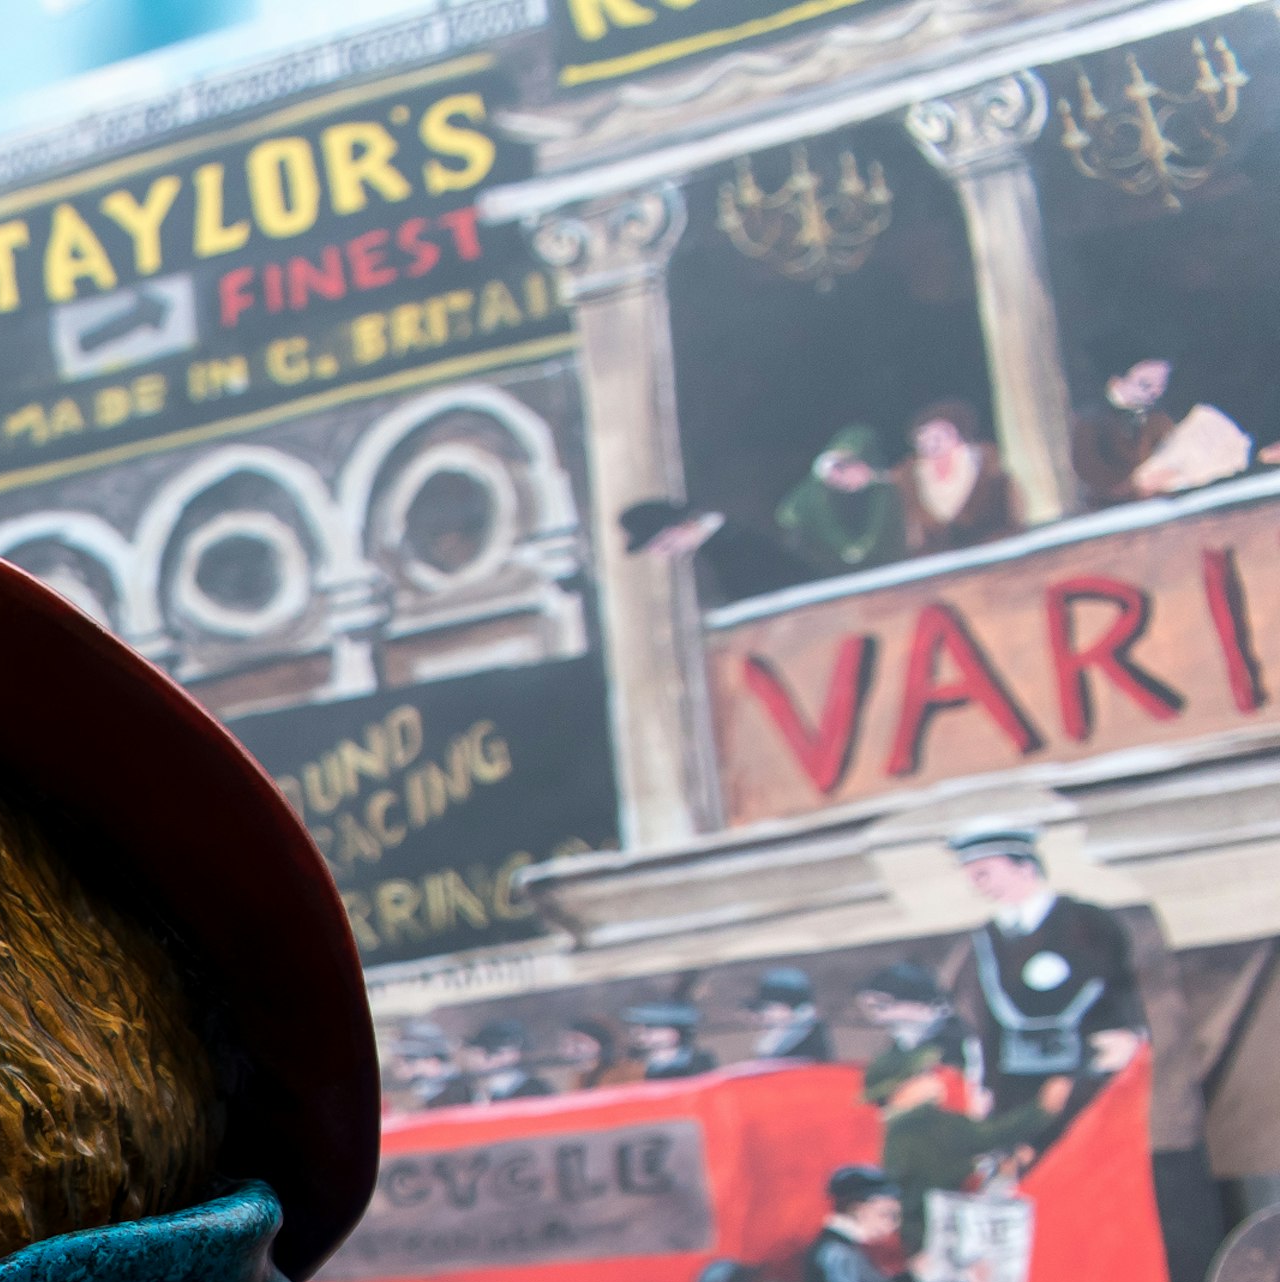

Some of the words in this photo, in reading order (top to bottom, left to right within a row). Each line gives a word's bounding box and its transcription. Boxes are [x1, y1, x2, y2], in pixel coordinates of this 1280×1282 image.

[219, 205, 483, 327] FINEST
[187, 355, 249, 402] IN
[351, 272, 562, 366] BRITAI
